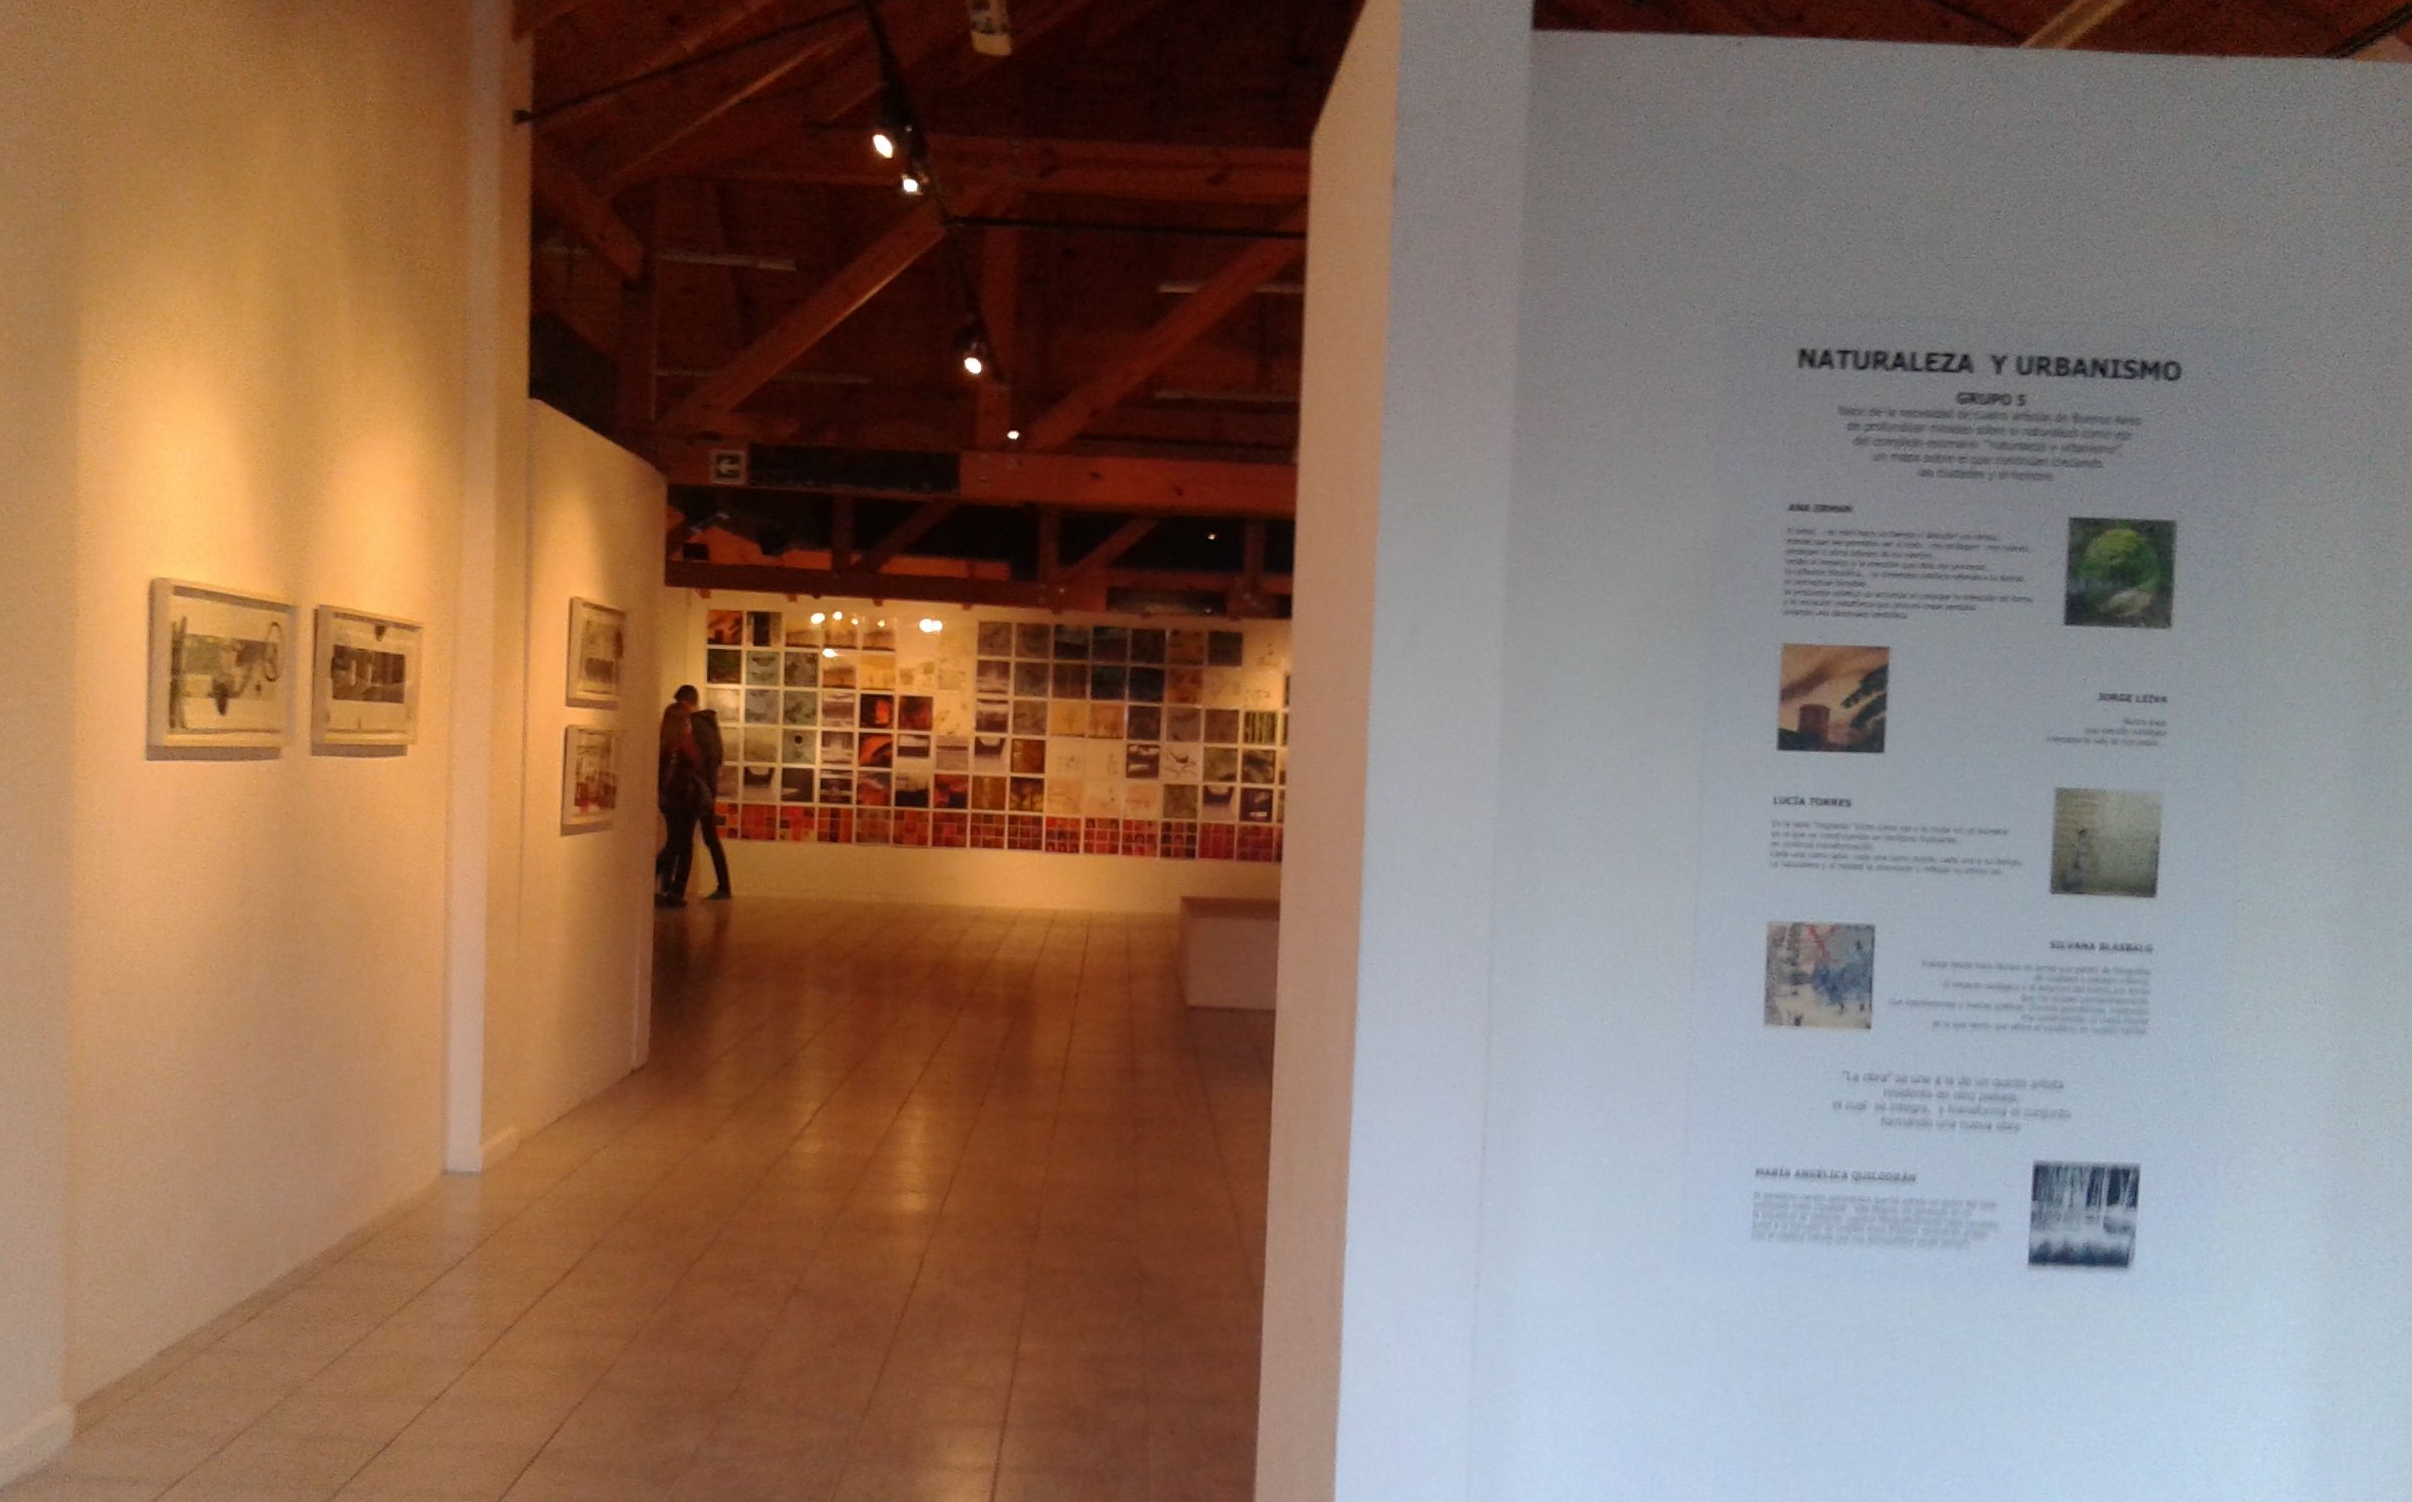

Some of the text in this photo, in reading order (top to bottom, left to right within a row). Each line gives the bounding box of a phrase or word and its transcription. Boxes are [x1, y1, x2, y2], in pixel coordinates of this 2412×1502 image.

[1798, 348, 2183, 382] NATURALEZA Y URBANISMO
[1956, 391, 2027, 407] GRUPO 5
[1809, 797, 1853, 808] TORRES
[2050, 940, 2096, 951] SILVANA
